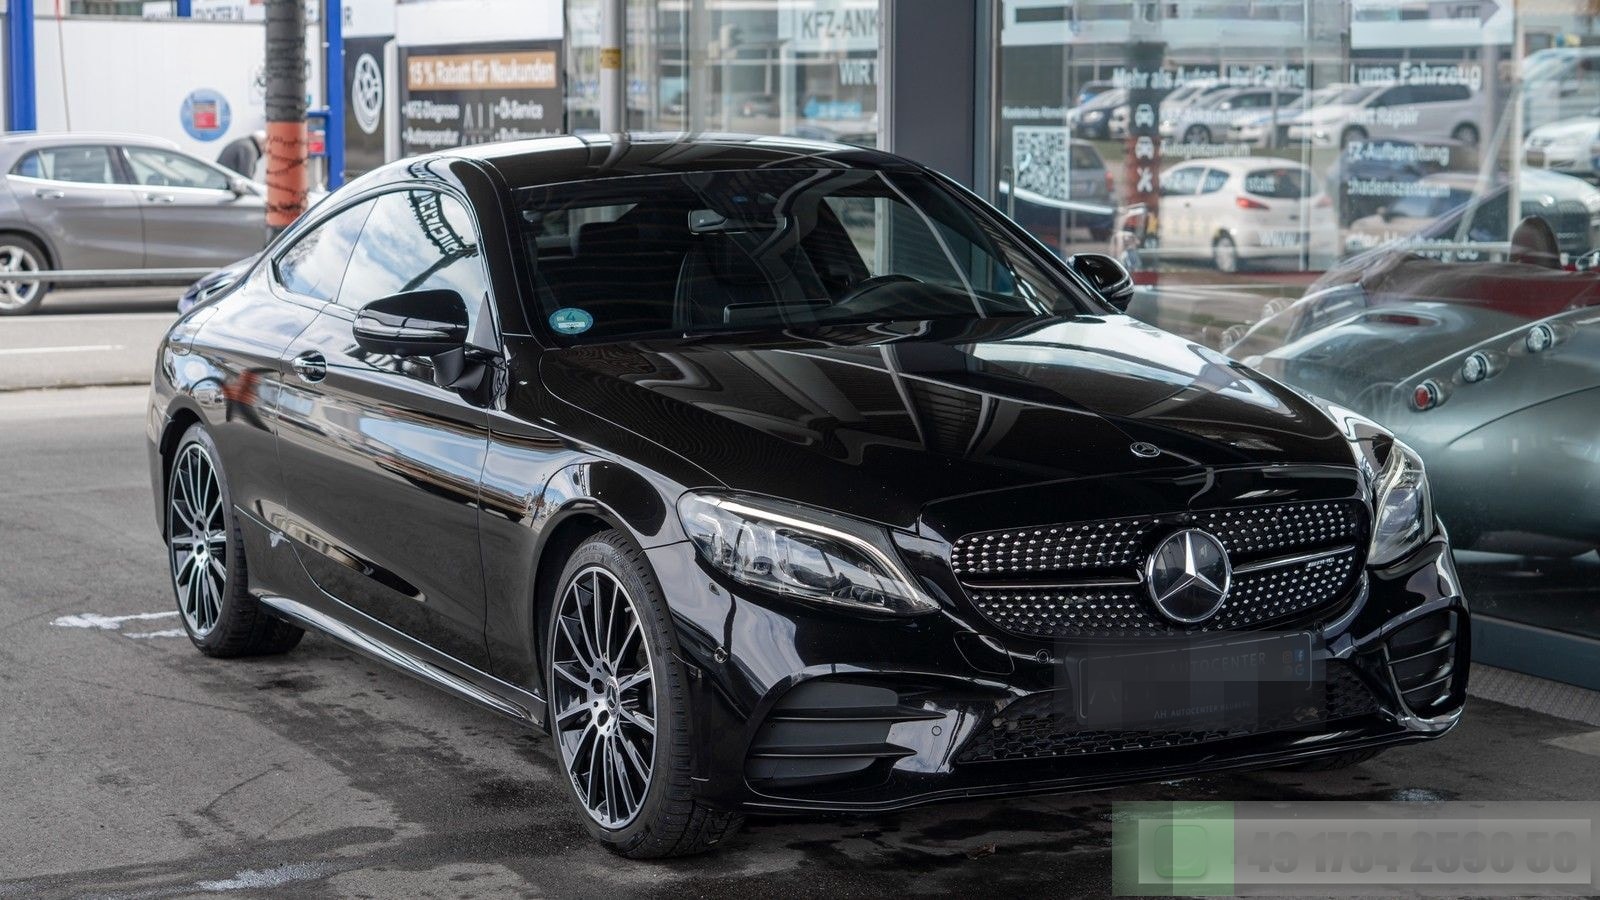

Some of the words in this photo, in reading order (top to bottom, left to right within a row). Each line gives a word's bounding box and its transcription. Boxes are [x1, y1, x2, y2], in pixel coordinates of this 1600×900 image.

[436, 60, 472, 84] Rabatt
[473, 59, 489, 83] für
[490, 57, 554, 83] Neukunden
[1113, 66, 1150, 89] Mehr
[1151, 67, 1174, 88] als
[1175, 66, 1218, 88] Autos
[1359, 67, 1396, 85] ums
[1399, 62, 1482, 91] Fahrzeug
[1376, 106, 1420, 128] Repair
